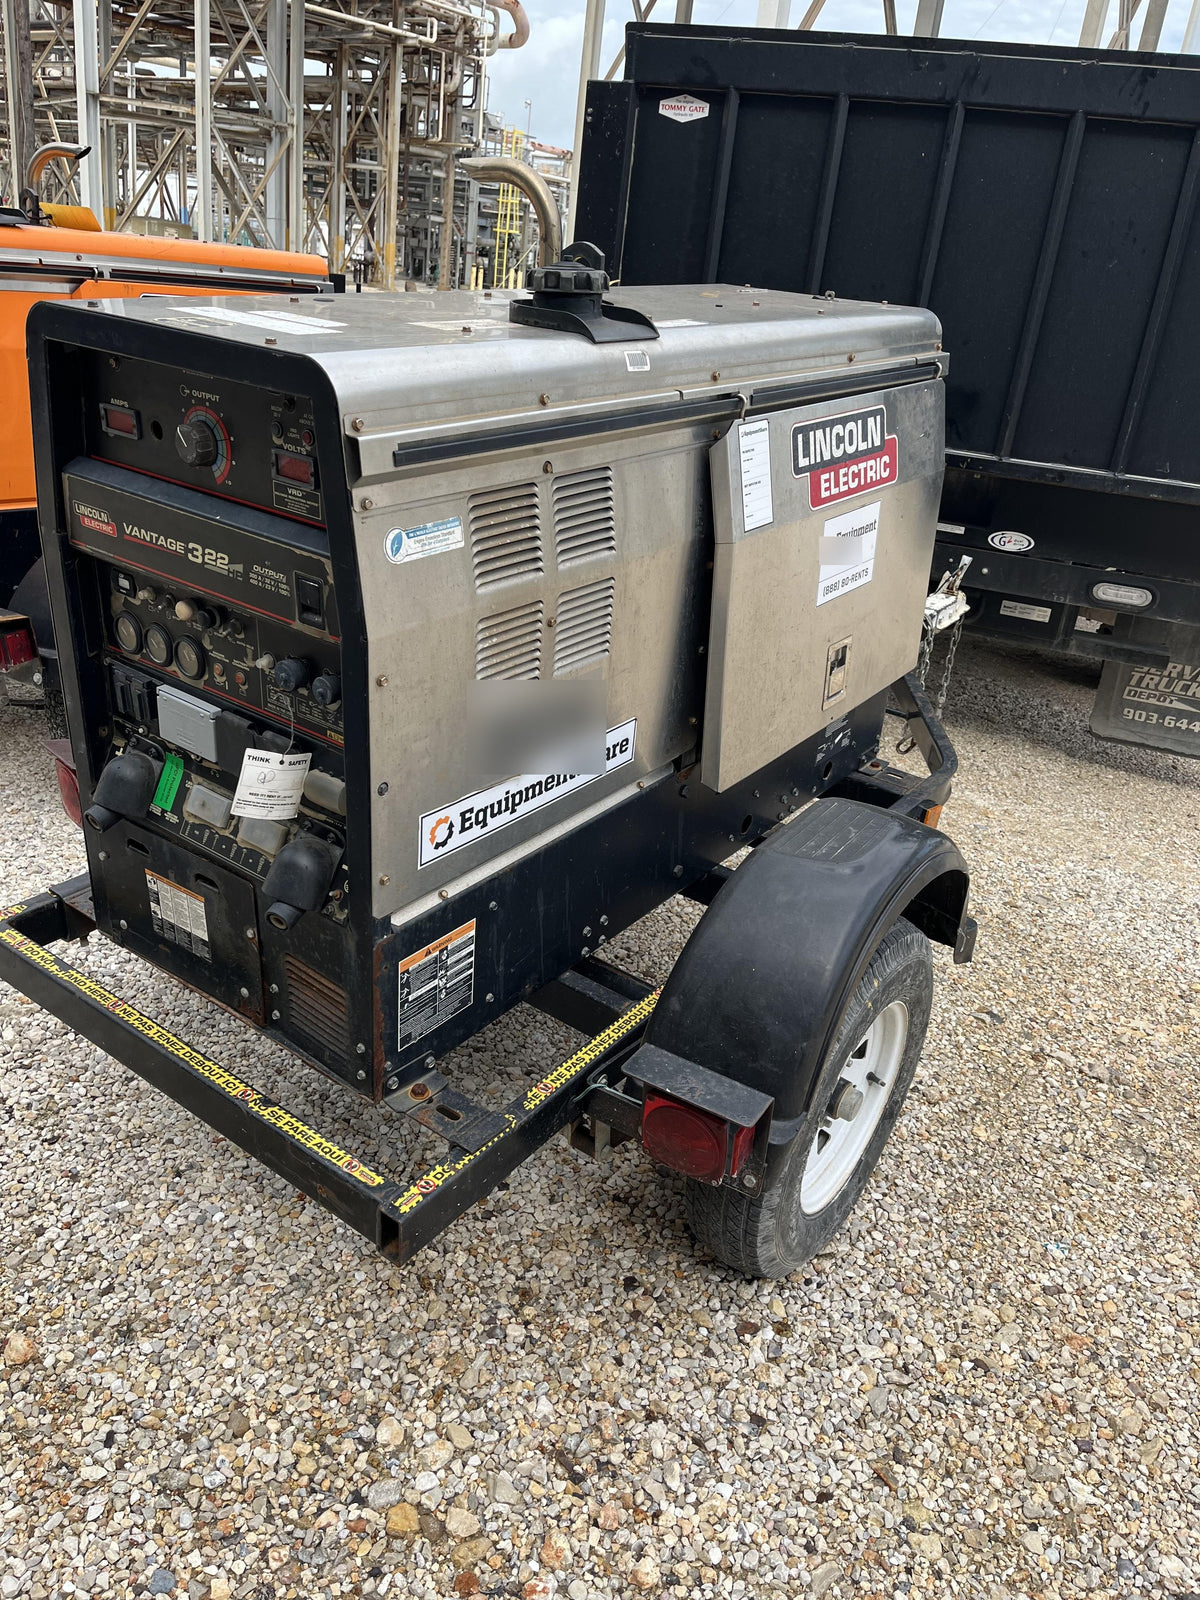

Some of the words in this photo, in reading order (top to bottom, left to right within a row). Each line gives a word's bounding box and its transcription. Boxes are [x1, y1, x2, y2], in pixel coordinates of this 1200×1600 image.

[661, 104, 686, 112] TOMMY
[110, 398, 128, 408] AMPS
[192, 390, 220, 402] OUTPUT
[282, 442, 306, 455] VOLTS
[798, 415, 880, 468] LINCOLN
[820, 455, 890, 498] ELECTRIC
[75, 503, 108, 523] LINCOLN
[84, 518, 113, 534] ELECTRIC
[122, 522, 185, 554] VANTAGE
[188, 542, 229, 570] 322
[253, 564, 284, 580] OUTPUT
[823, 580, 840, 597] (888)
[1129, 672, 1200, 698] TRUCK
[1126, 690, 1178, 704] DEPOT
[1123, 708, 1200, 732] 903-644
[247, 754, 270, 764] THINK
[24, 946, 40, 956] DO
[84, 985, 113, 1003] HERE
[119, 1006, 134, 1019] NE
[133, 1015, 153, 1031] PAS
[153, 1028, 186, 1054] TENEZ
[182, 1050, 226, 1081] DEBOUT
[222, 1076, 240, 1092] ICI
[550, 1071, 567, 1084] NE
[565, 1057, 585, 1072] PAS
[582, 1034, 614, 1056] TENEZ
[612, 1007, 646, 1034] DEBOUT
[645, 998, 658, 1007] ICI
[267, 1110, 286, 1122] SE
[283, 1121, 316, 1143] PARE
